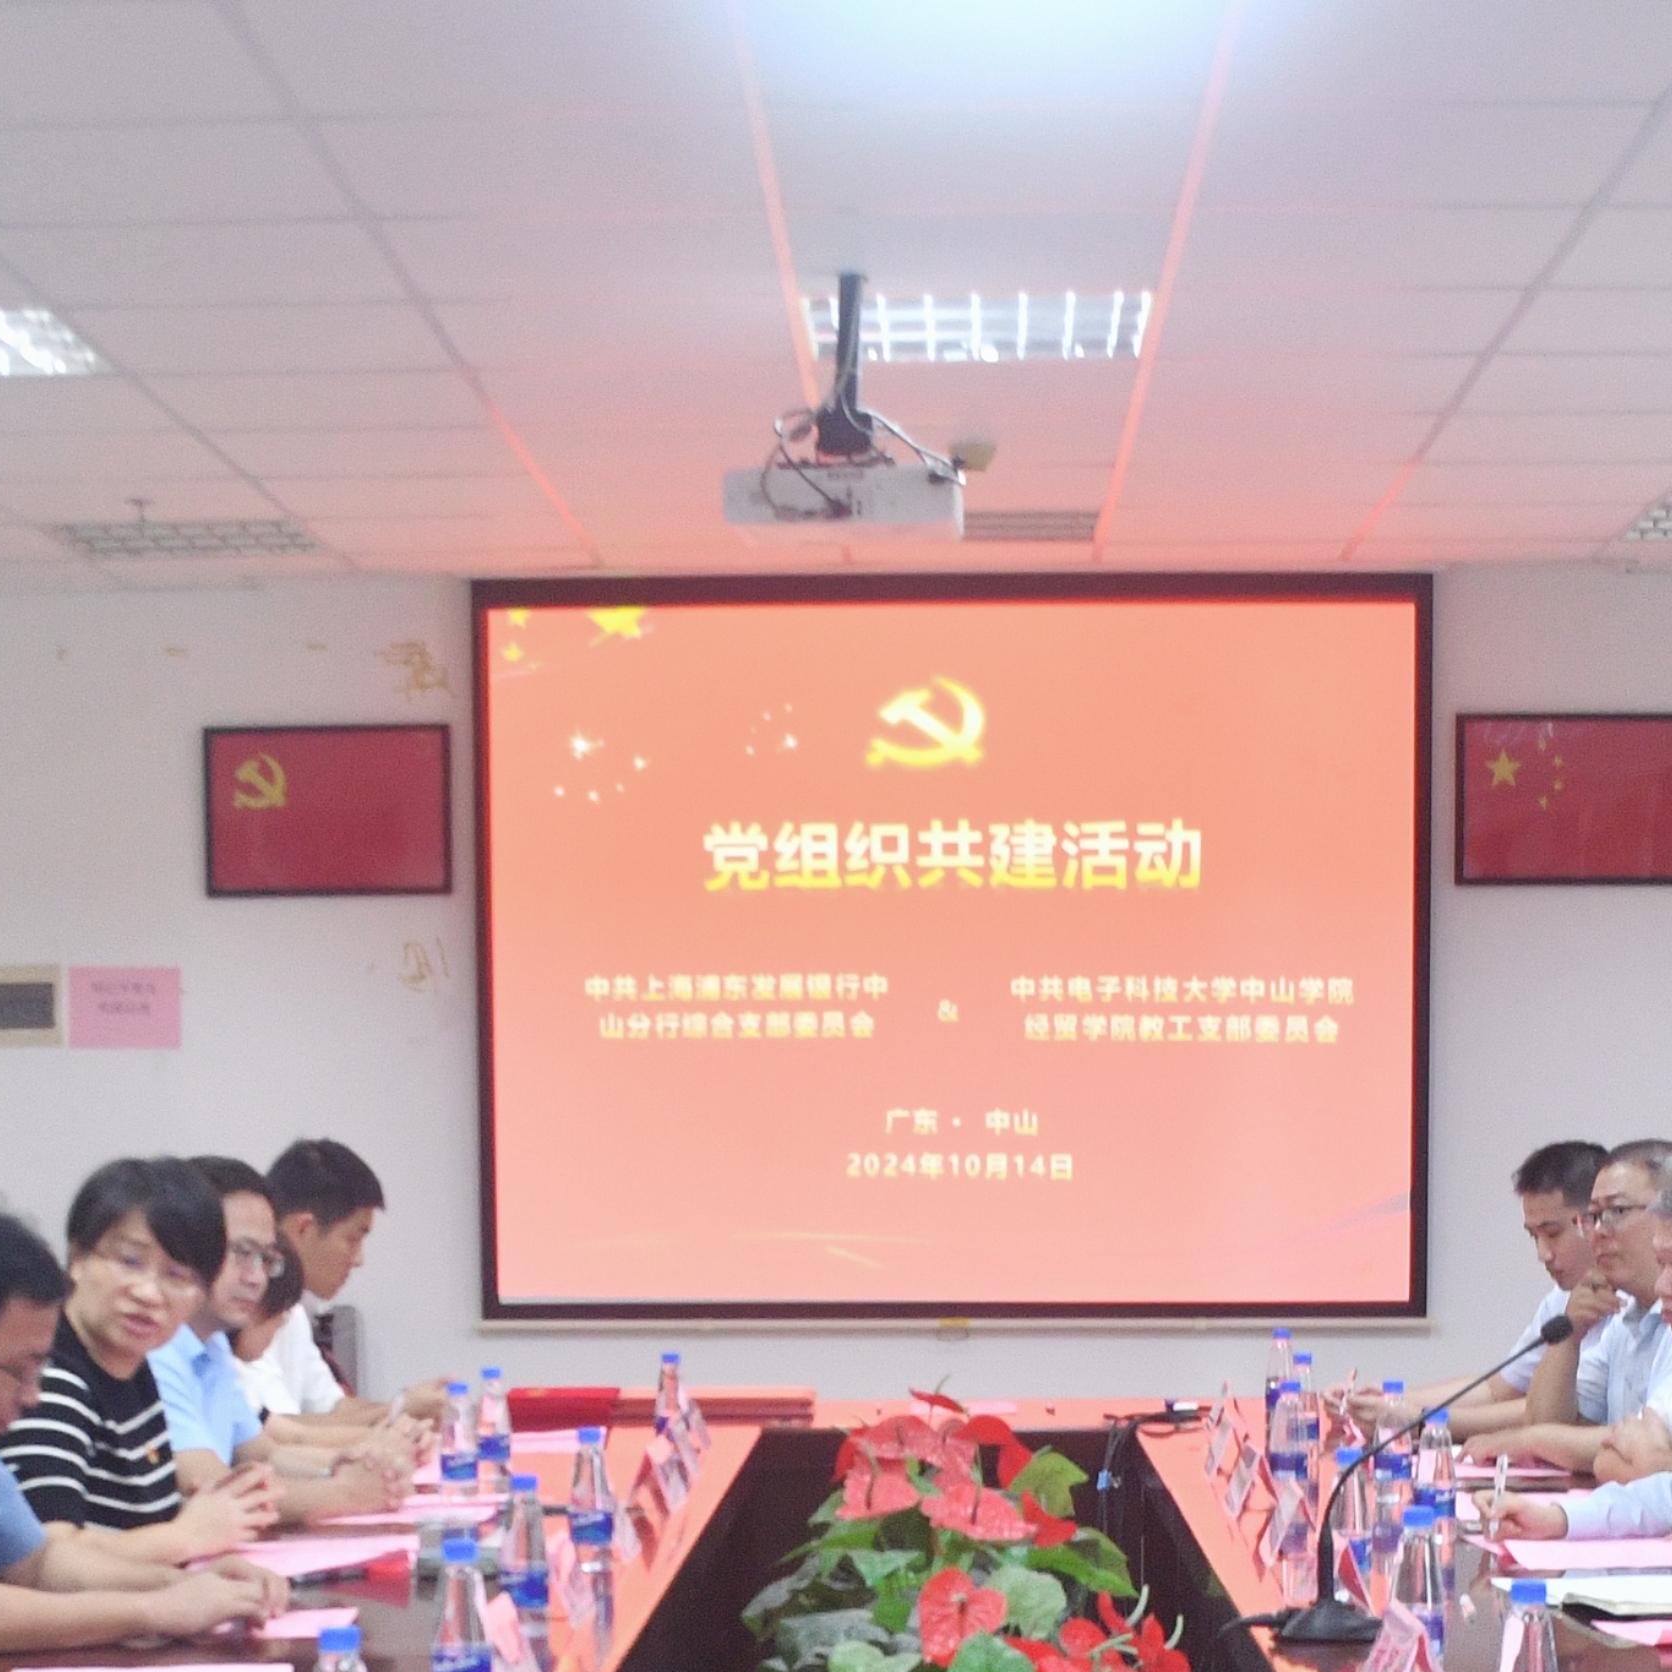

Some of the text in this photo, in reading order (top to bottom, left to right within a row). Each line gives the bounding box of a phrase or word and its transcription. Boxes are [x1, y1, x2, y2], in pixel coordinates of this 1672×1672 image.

[704, 818, 1202, 891] 党组织共建活动
[584, 973, 888, 1001] 中共上海浦东发展银行中
[1010, 975, 1355, 1005] 中共电子科技大学中山学院
[599, 1010, 875, 1039] 山分行综合支部委员会
[938, 999, 959, 1022] &
[1024, 1014, 1339, 1042] 经贸学院教工支部委员会
[846, 1152, 1073, 1180] 2024年10月14日
